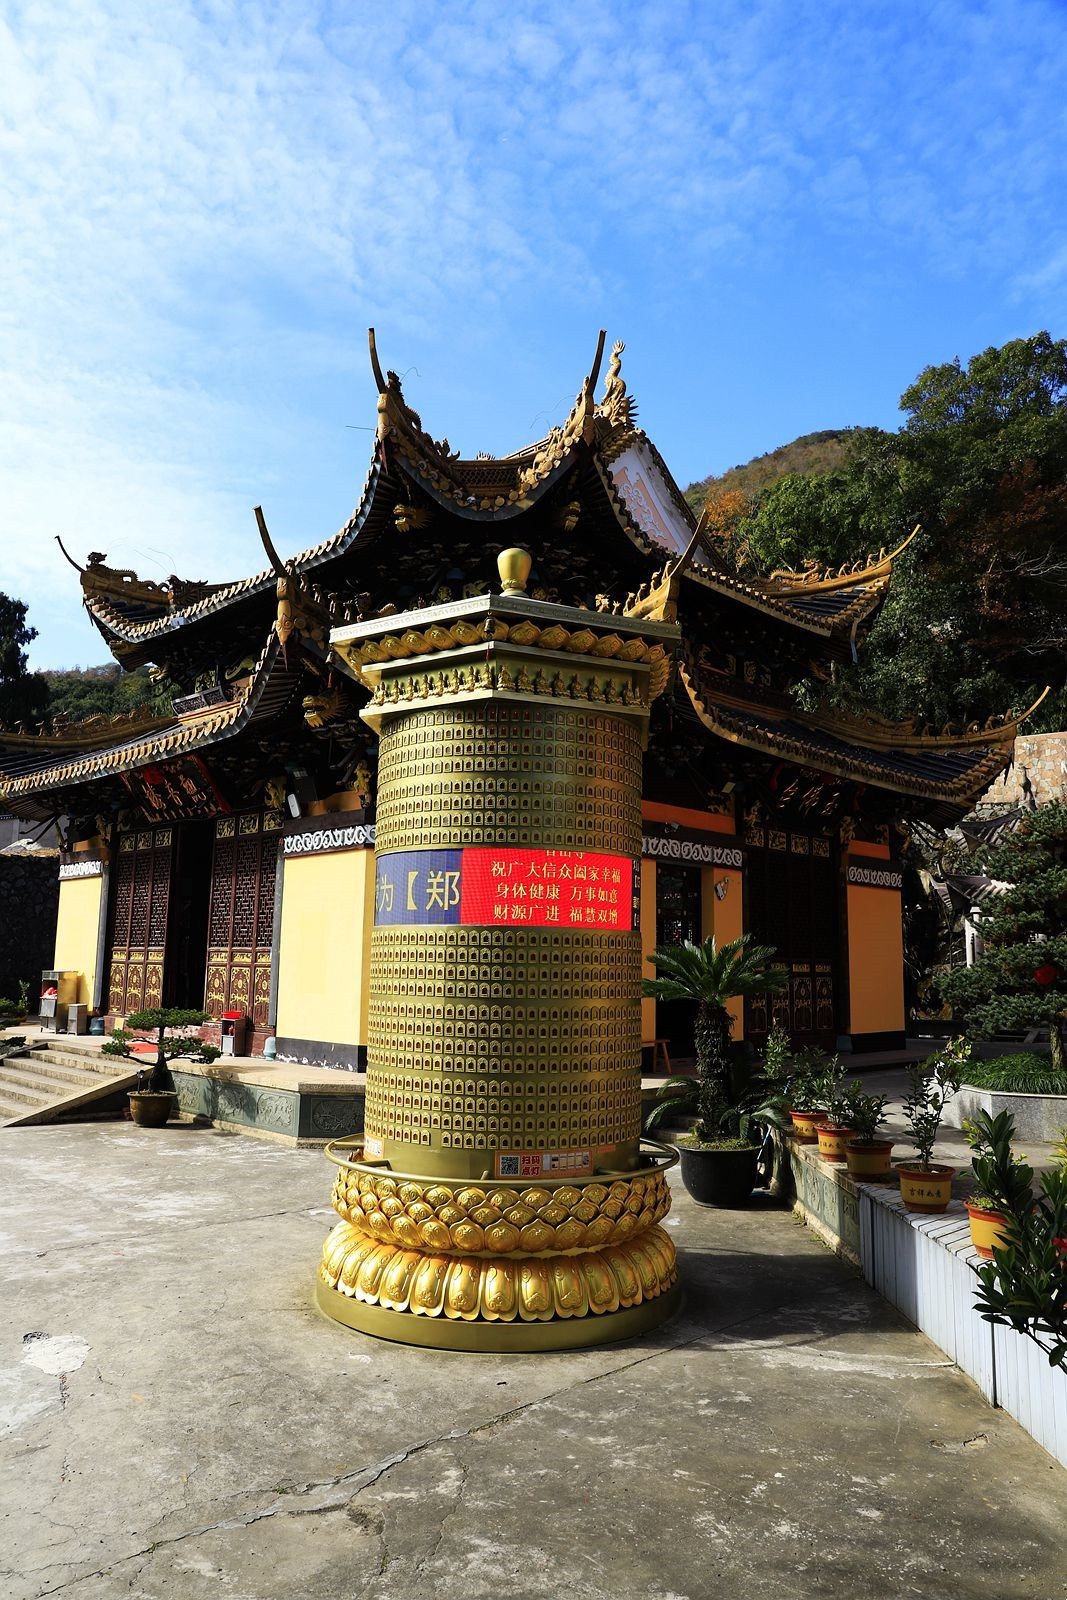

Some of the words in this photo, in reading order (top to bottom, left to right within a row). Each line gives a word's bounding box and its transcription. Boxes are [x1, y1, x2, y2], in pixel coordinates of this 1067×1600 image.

[491, 860, 621, 884] 祝广大信众阖家幸福
[495, 882, 561, 900] 身体健康
[570, 886, 618, 904] 万事如意
[493, 904, 560, 921] 财源广进
[569, 906, 618, 925] 福慧双增
[522, 1155, 540, 1165] 扫码
[522, 1166, 540, 1176] 点灯
